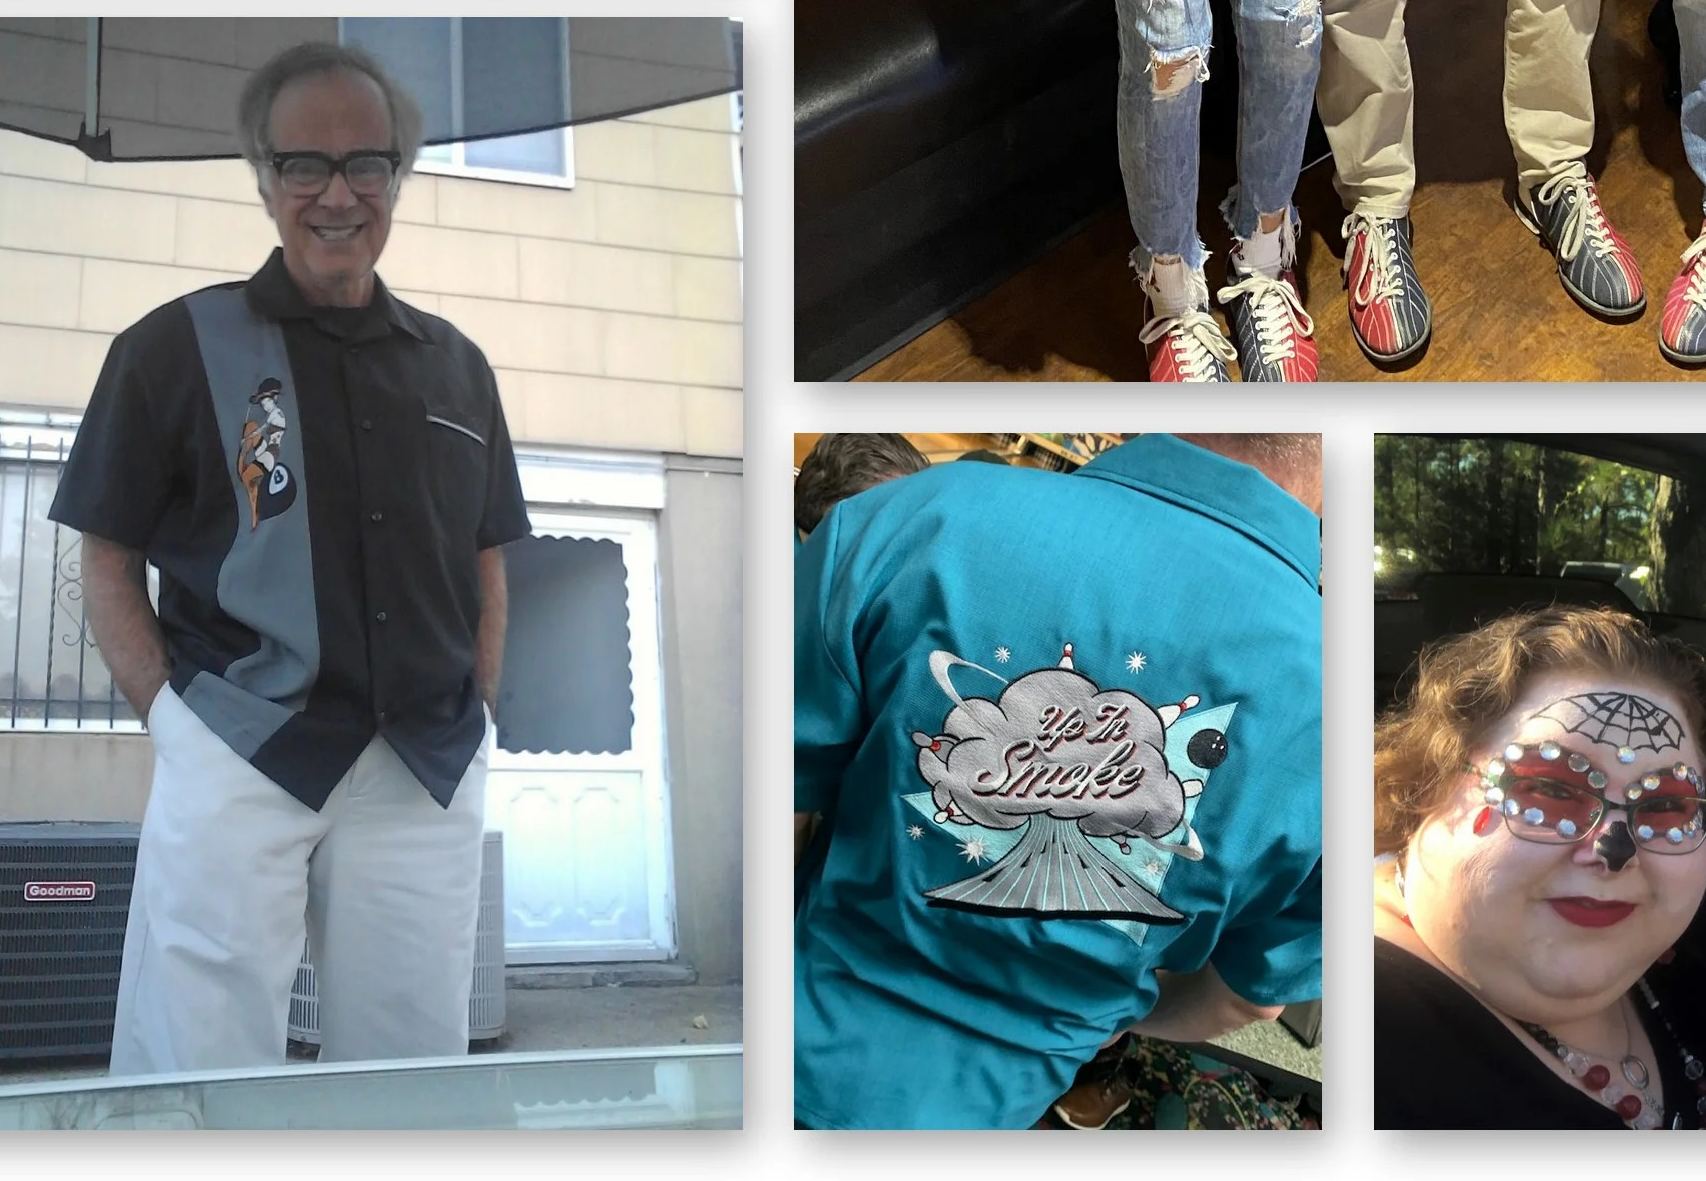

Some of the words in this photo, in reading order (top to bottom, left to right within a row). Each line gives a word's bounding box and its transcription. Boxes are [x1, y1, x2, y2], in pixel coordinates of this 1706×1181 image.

[1037, 705, 1085, 752] Up
[1086, 703, 1131, 743] In
[971, 739, 1145, 799] Smoke
[29, 885, 91, 896] Goodman
